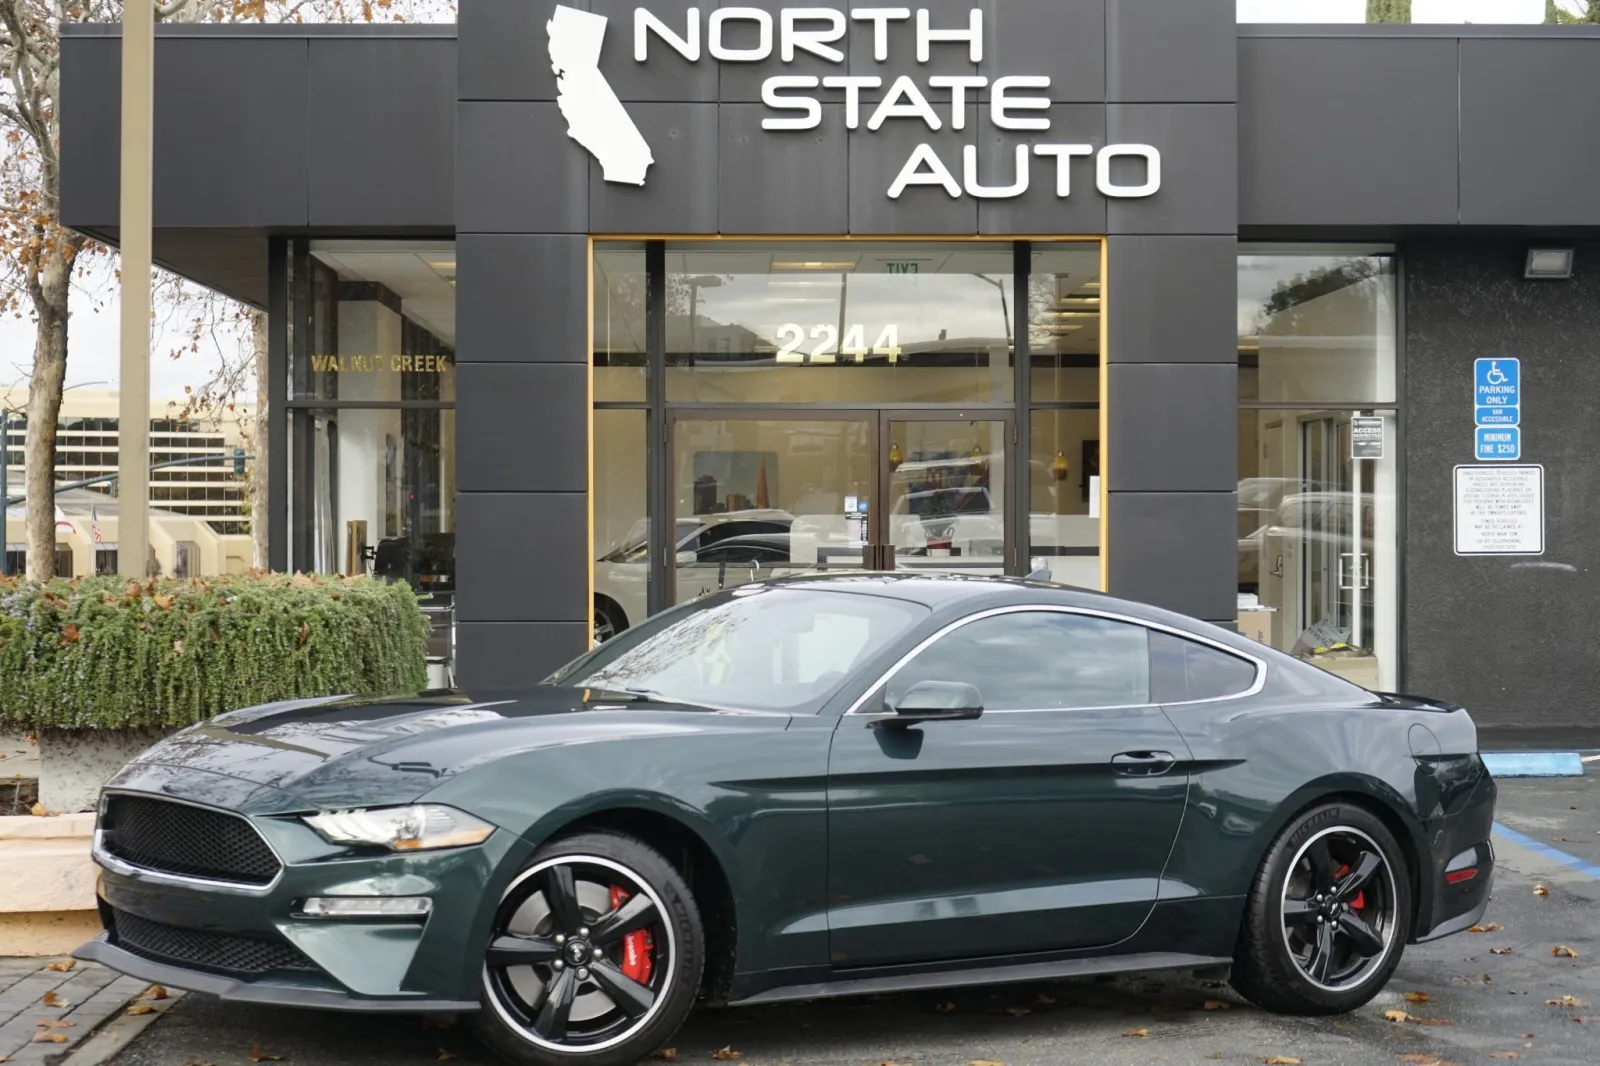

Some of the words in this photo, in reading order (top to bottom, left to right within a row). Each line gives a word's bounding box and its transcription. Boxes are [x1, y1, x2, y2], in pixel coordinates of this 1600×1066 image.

[634, 7, 983, 62] NORTH
[761, 75, 1051, 130] STATE
[887, 143, 1162, 199] AUTO
[776, 323, 902, 363] 2244
[311, 355, 385, 372] WALNUT
[390, 355, 447, 372] CREEK
[1479, 385, 1516, 394] PARKING
[1486, 396, 1508, 405] ONLY
[1480, 444, 1495, 454] FINE
[1497, 444, 1516, 454] $250
[1483, 433, 1512, 442] MINIMUM
[627, 935, 637, 966] brembo
